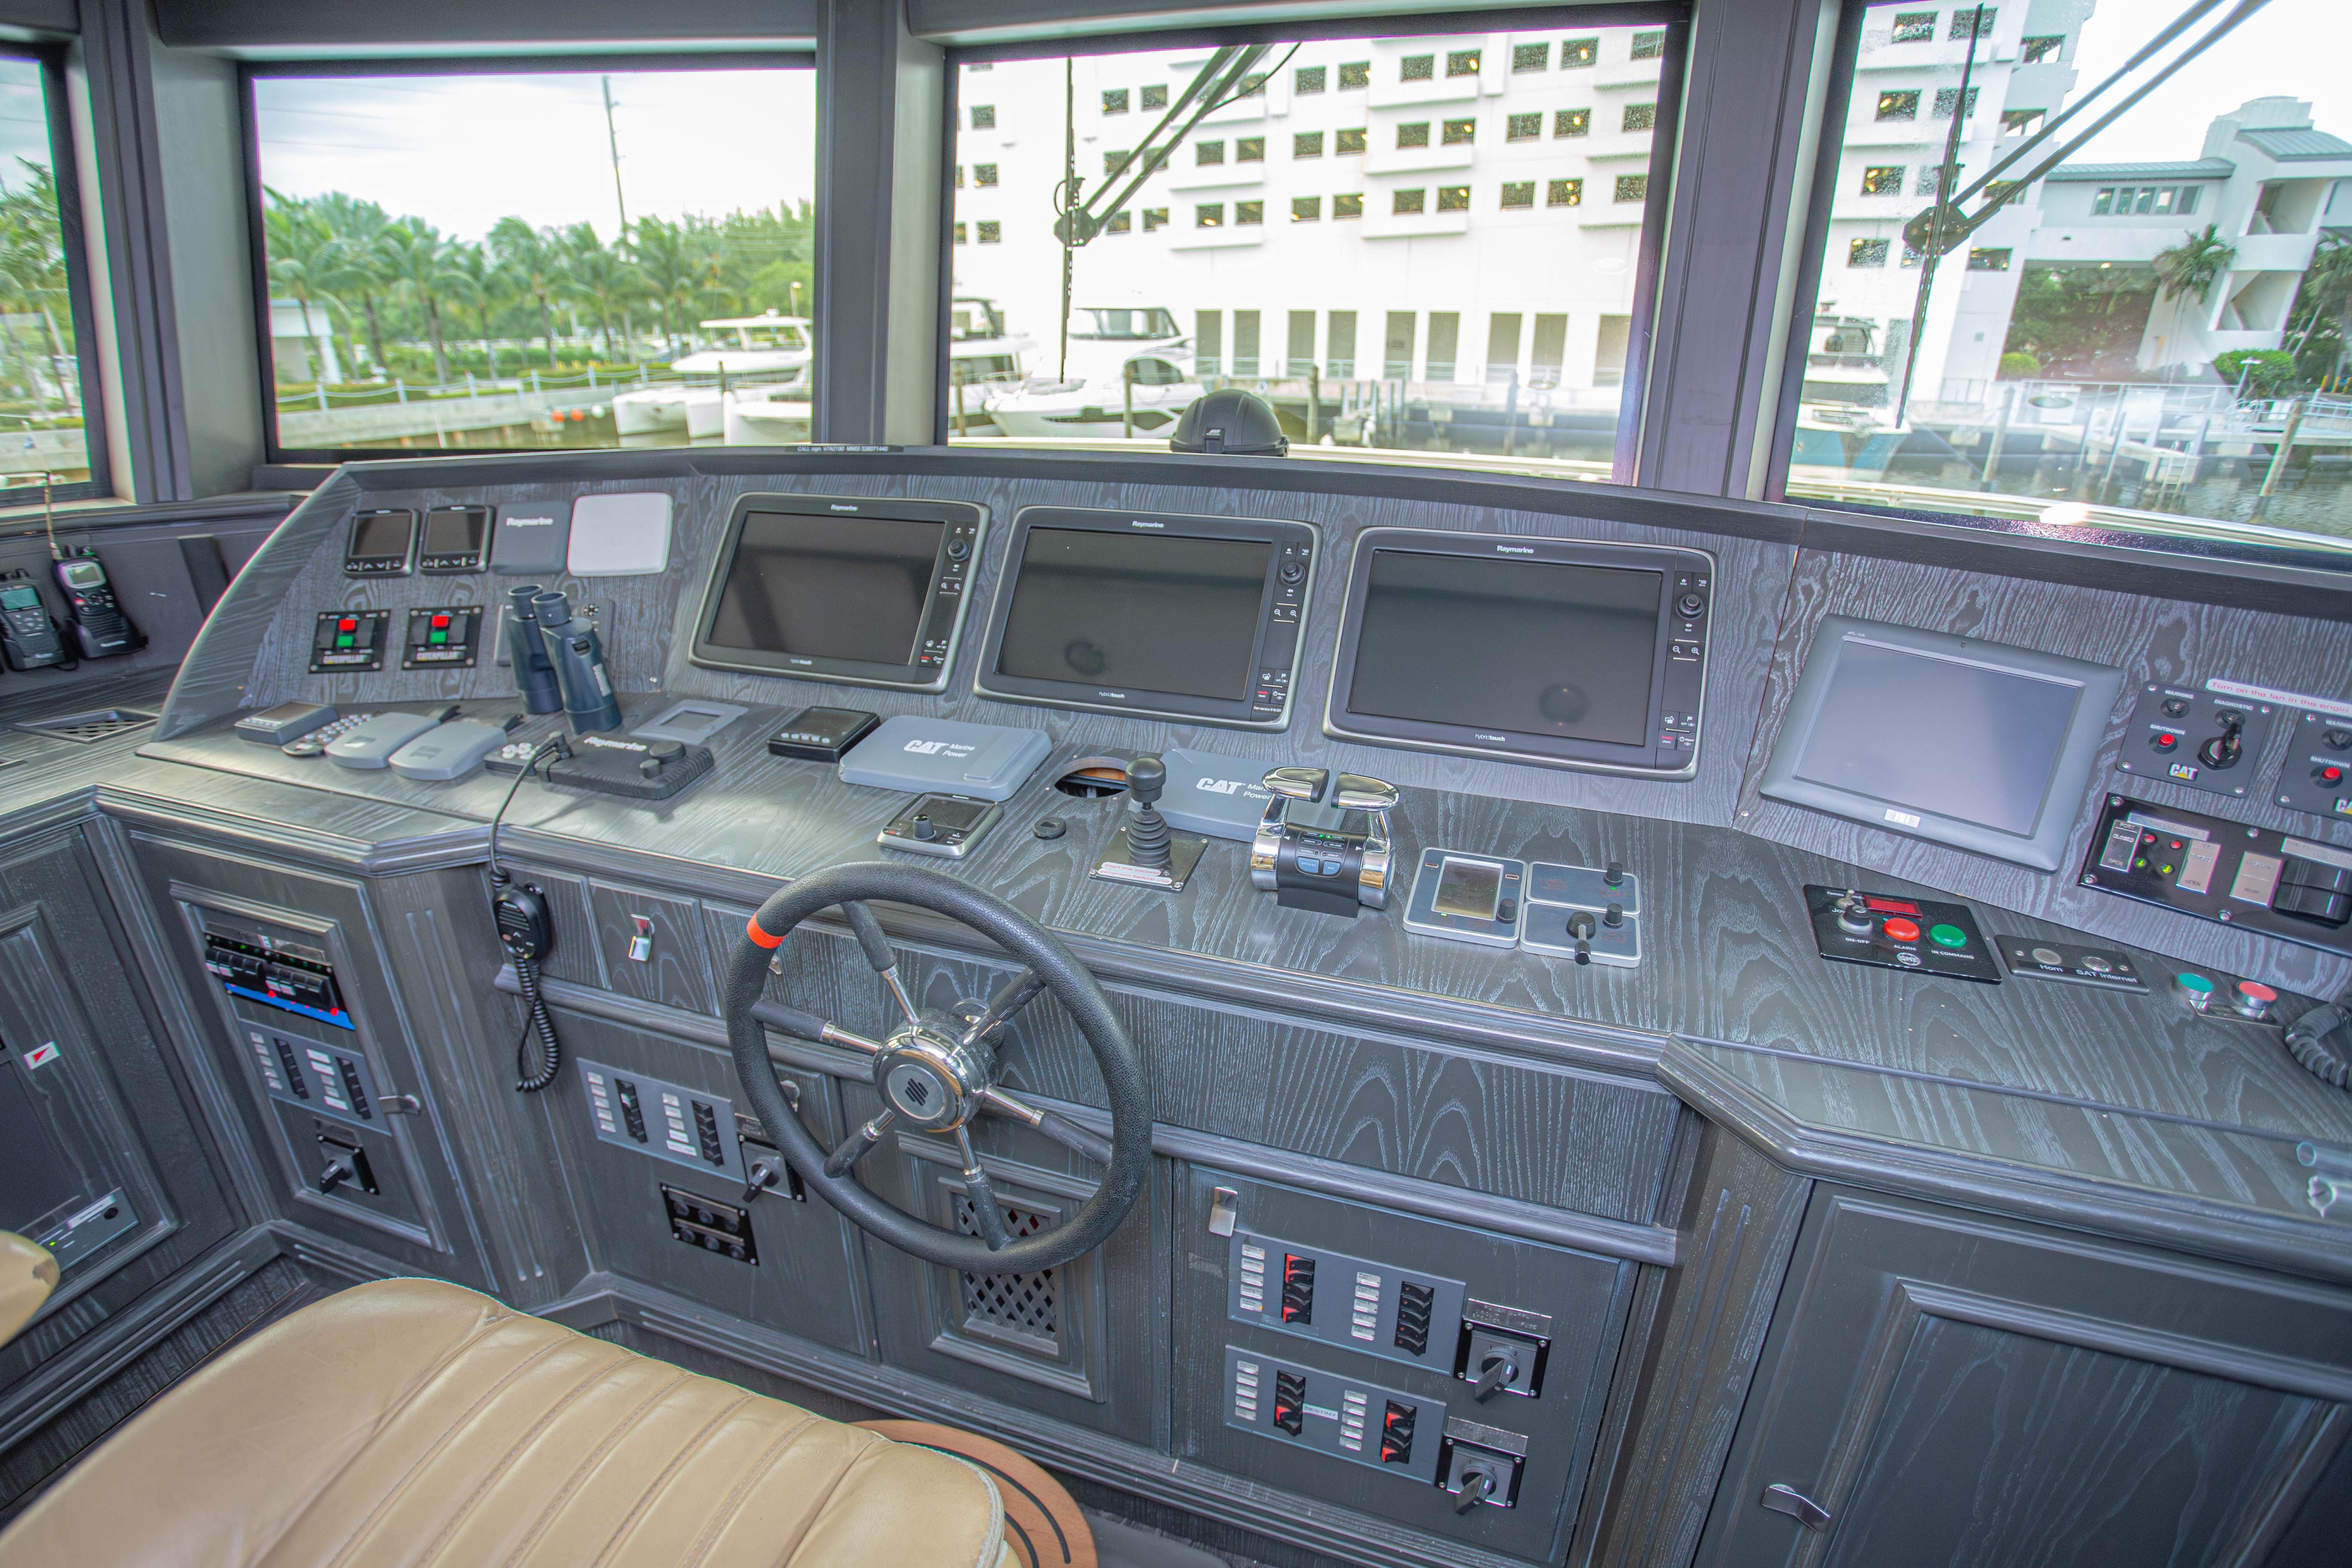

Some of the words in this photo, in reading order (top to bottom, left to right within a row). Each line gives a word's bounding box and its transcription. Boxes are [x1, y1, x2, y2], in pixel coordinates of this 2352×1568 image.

[506, 517, 553, 527] Raymarine
[1497, 545, 1534, 554] Raymarine
[2211, 682, 2233, 691] Turn
[2164, 690, 2194, 699] WARNING
[2213, 699, 2254, 711] DIAGNOSTIC
[2149, 724, 2186, 735] SHUTDOWN
[1475, 733, 1505, 742] hybridtouch
[583, 736, 648, 751] Raymarine
[904, 740, 947, 754] CAT
[2310, 755, 2351, 769] SHUTDOWN
[2169, 763, 2199, 780] CAT
[1196, 777, 1243, 795] CAT
[1243, 791, 1272, 799] Power
[2113, 833, 2134, 843] CLOSED
[1099, 869, 1132, 878] generator
[1939, 950, 1975, 959] COMMAND
[2039, 964, 2063, 972] Horn
[2075, 969, 2097, 977] SAT
[2099, 972, 2138, 983] Internet
[1304, 1406, 1336, 1417] DESTINY
